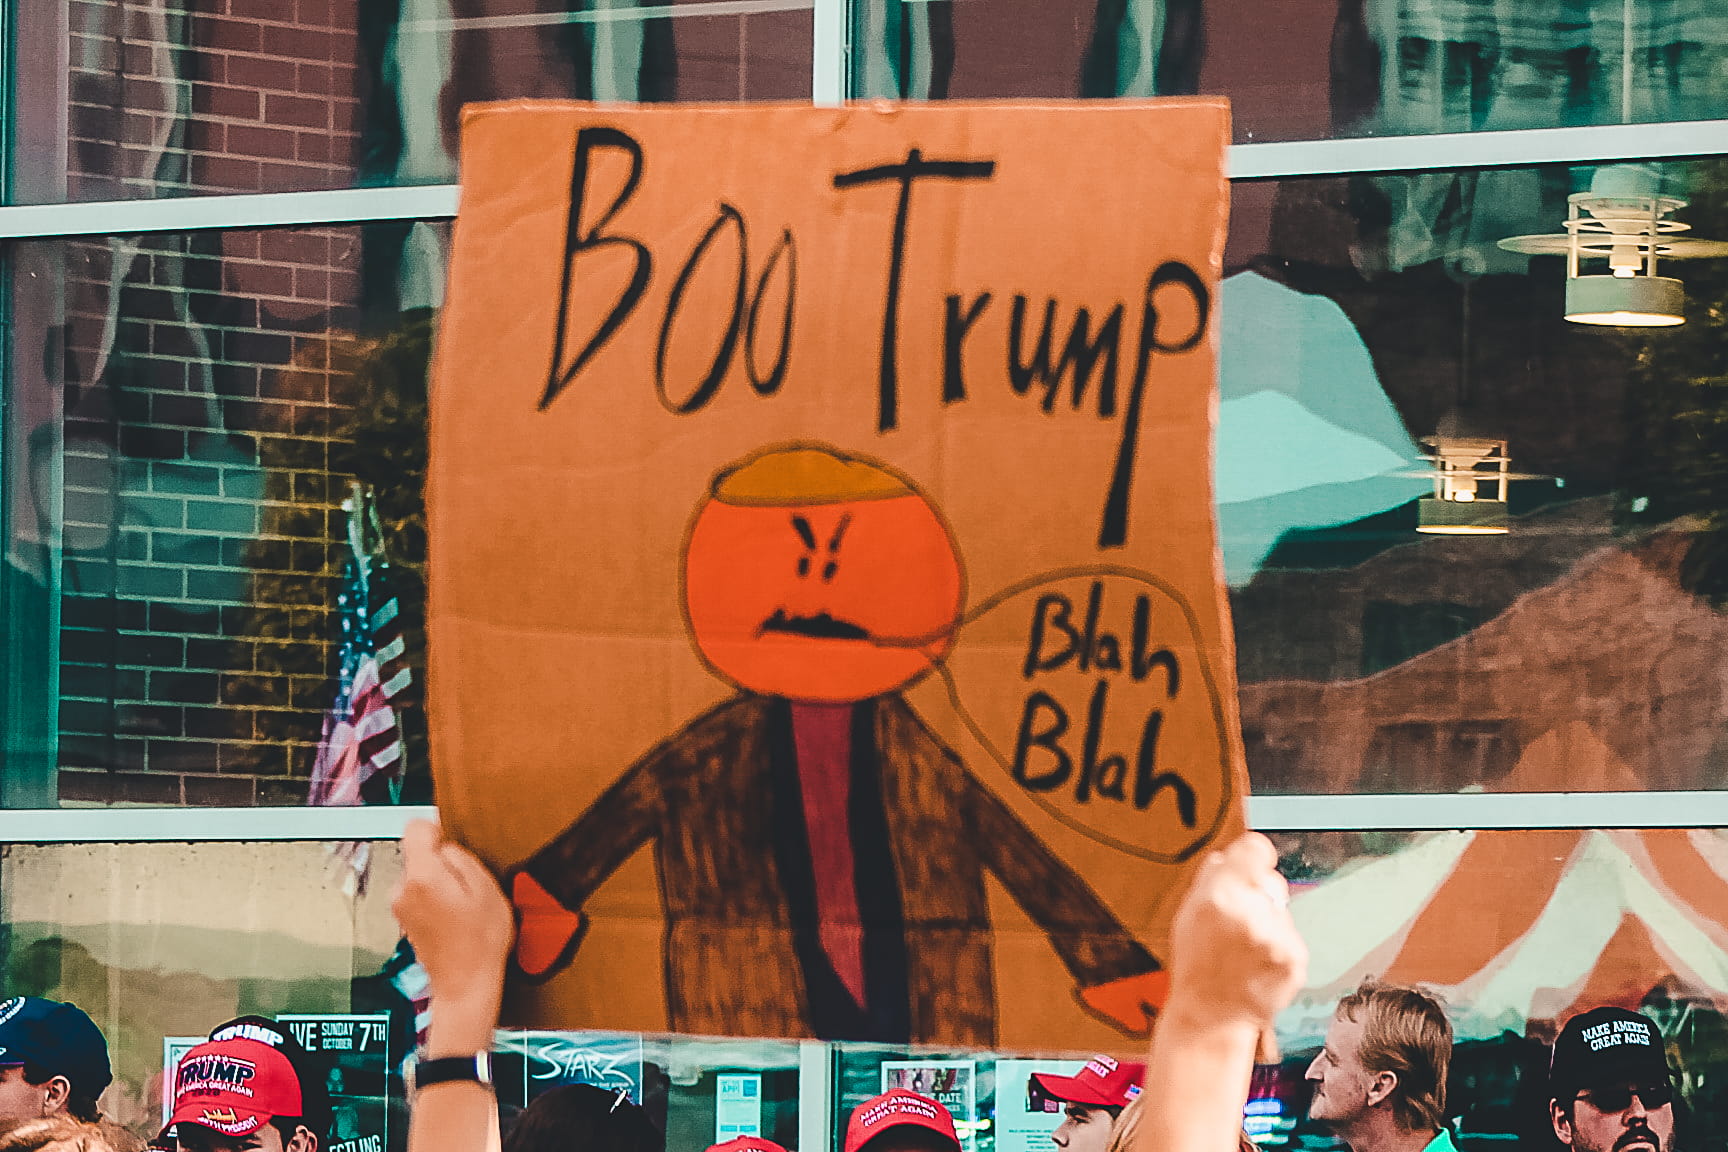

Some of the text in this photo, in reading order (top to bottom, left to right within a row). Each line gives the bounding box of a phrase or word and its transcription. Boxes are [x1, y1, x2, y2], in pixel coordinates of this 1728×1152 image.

[537, 127, 1213, 549] Boo Trump
[1021, 579, 1180, 698] Blah
[1011, 678, 1198, 829] Blah
[321, 1022, 354, 1036] SUNDAY
[1581, 1020, 1651, 1042] MAKE AMERICA
[322, 1037, 353, 1050] OCTOBER
[1590, 1032, 1651, 1052] GREAT AGAIN
[179, 1060, 256, 1087] TRUMP
